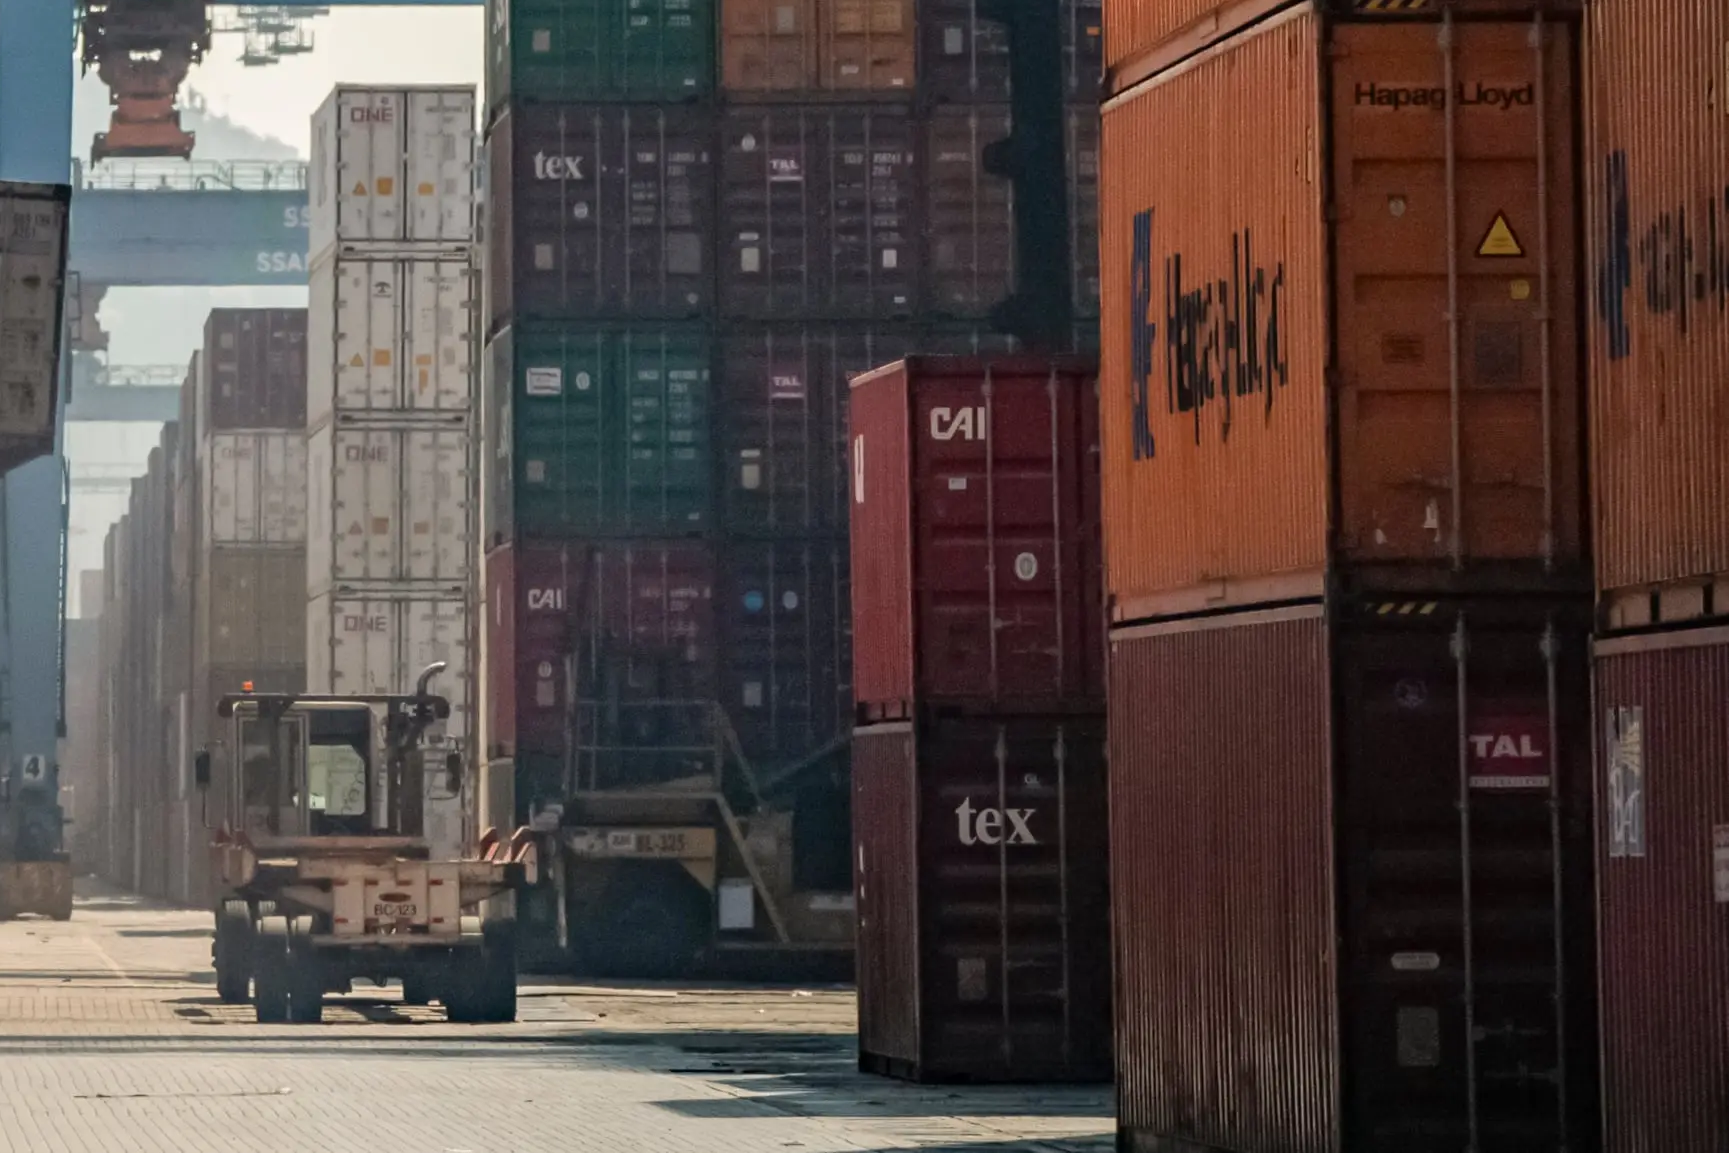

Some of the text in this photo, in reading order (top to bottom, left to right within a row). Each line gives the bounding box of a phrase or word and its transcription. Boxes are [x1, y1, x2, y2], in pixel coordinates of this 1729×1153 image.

[350, 107, 393, 123] ONE
[533, 150, 584, 180] tex
[931, 407, 986, 440] CAI
[345, 445, 389, 462] ONE
[528, 588, 562, 610] CAI
[344, 615, 387, 632] ONE
[1468, 733, 1542, 759] TAL
[24, 757, 40, 778] 4
[955, 796, 1038, 845] tex
